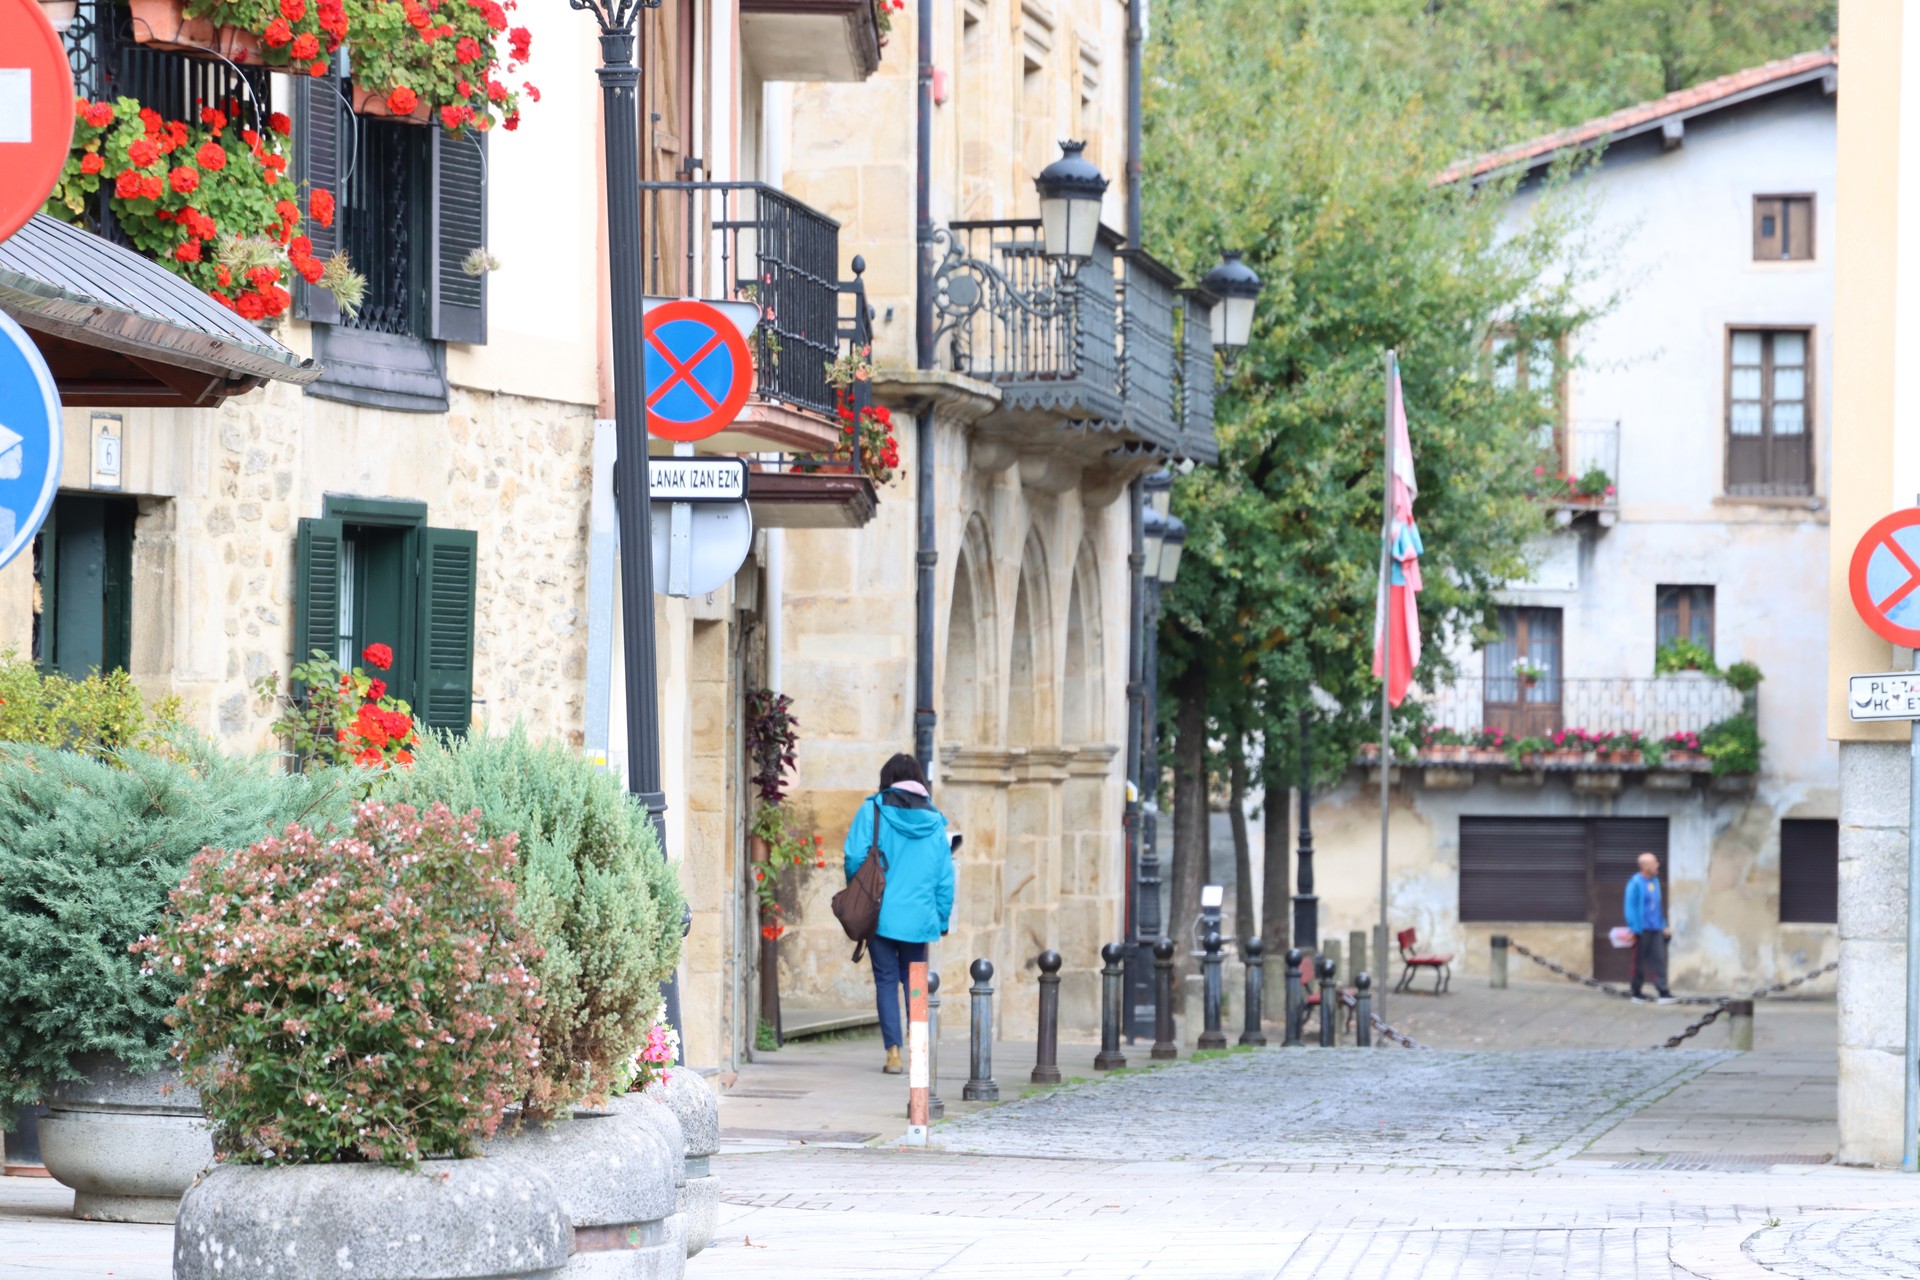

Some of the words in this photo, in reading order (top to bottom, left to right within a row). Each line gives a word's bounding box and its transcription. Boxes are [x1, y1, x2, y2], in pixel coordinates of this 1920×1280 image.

[106, 443, 113, 466] 6
[690, 469, 715, 488] IZAN
[718, 469, 740, 488] EZIK
